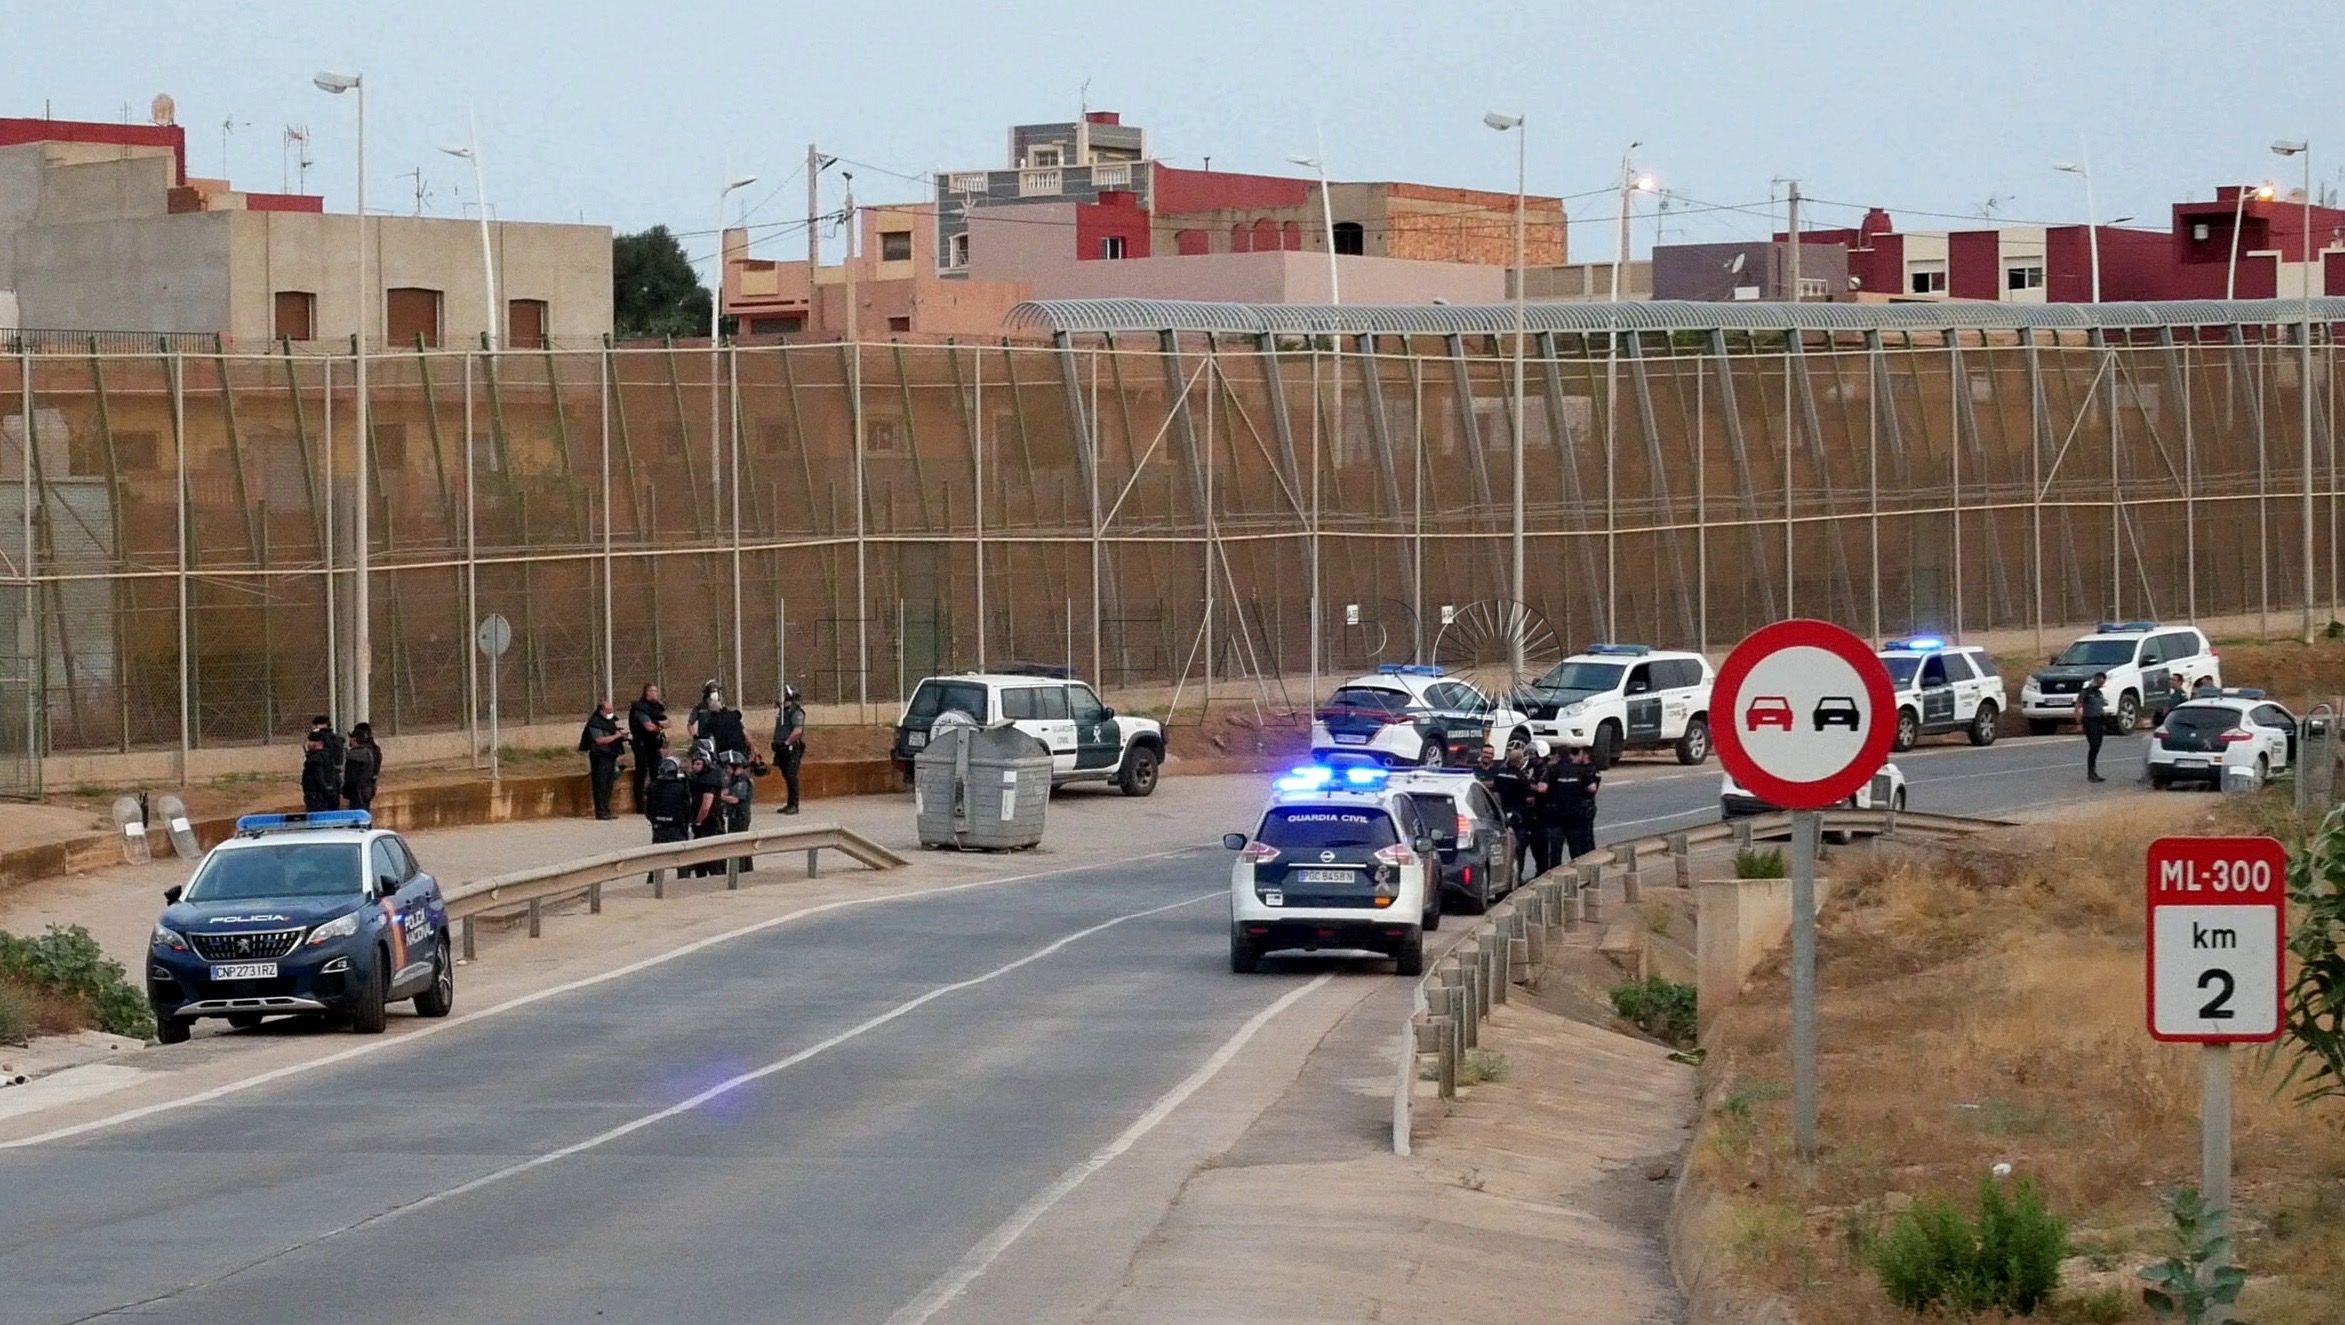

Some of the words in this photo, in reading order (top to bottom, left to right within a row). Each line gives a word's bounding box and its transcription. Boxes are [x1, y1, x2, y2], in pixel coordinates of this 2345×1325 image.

[1287, 814, 1339, 823] GUARDIA
[1341, 814, 1369, 824] CIVIL
[2160, 860, 2271, 892] ML-300
[209, 914, 285, 924] POLICIA
[2192, 921, 2236, 949] km
[2197, 968, 2235, 1019] 2
